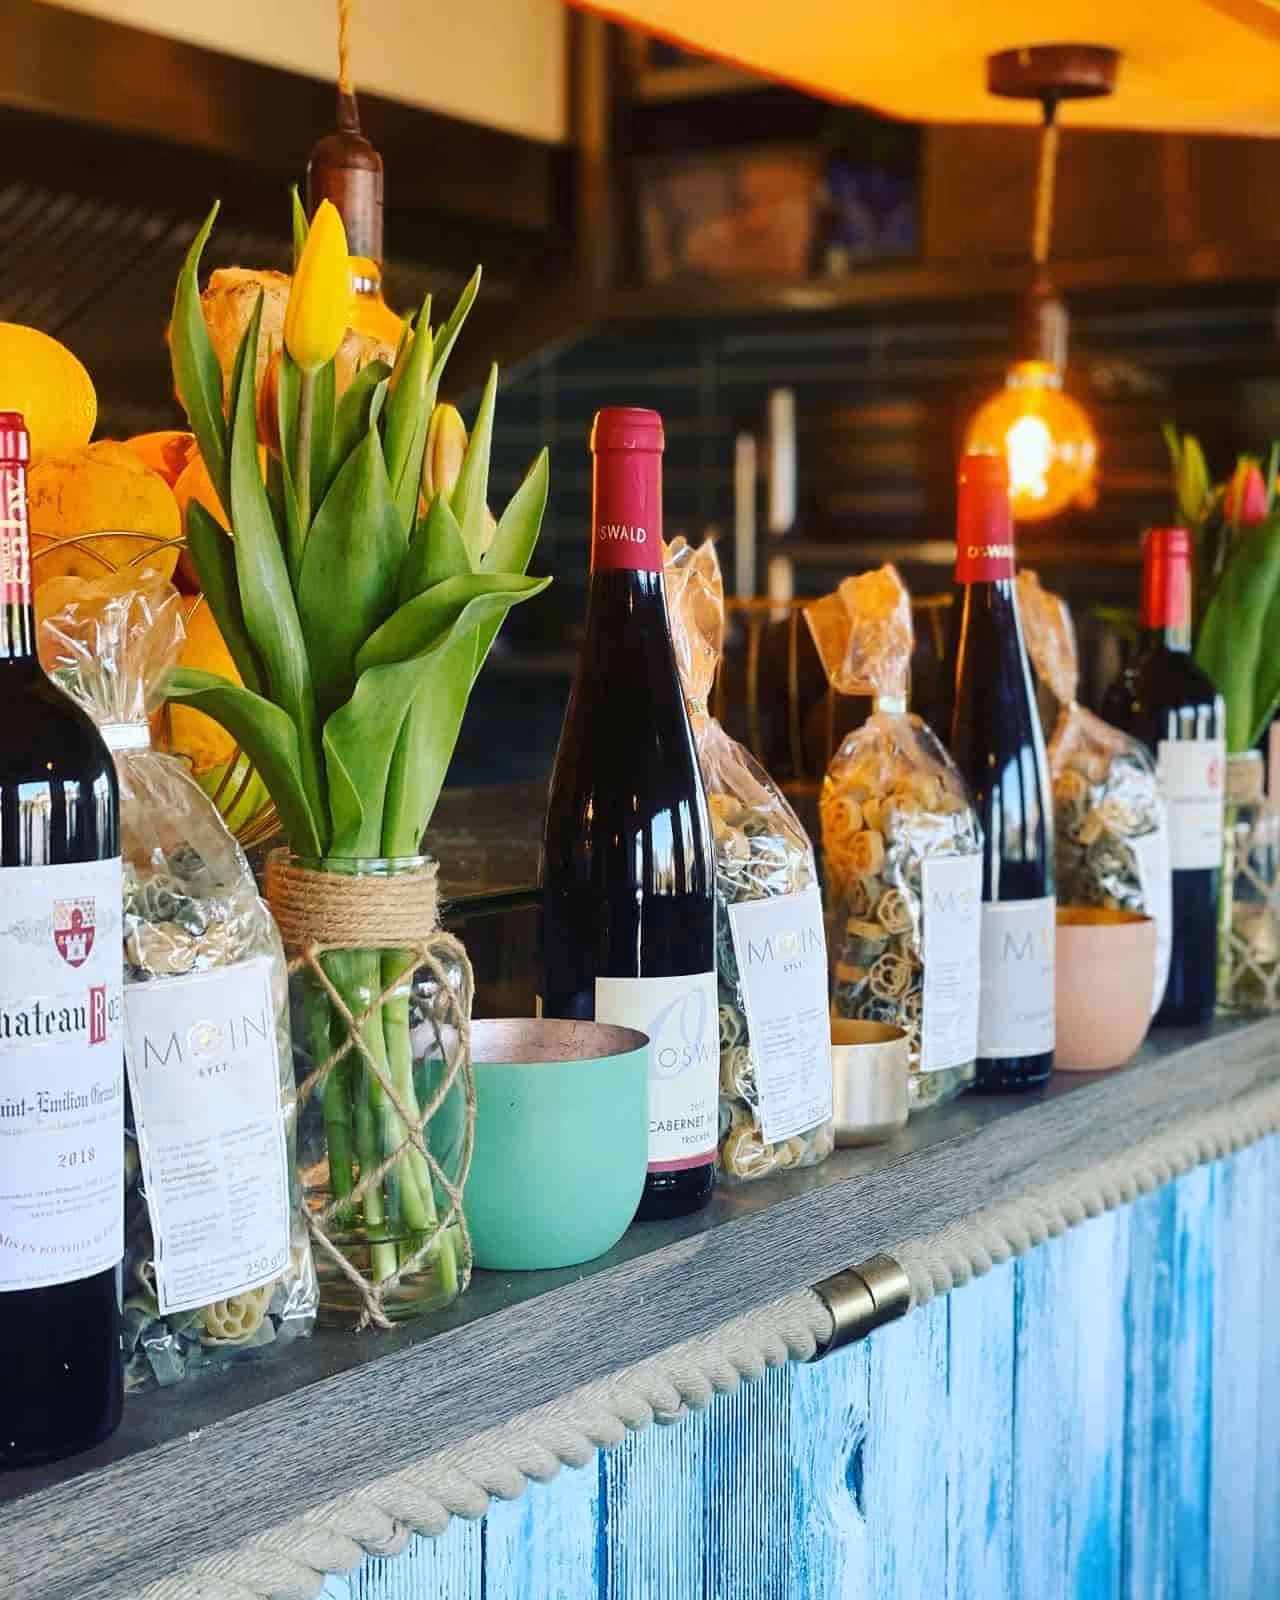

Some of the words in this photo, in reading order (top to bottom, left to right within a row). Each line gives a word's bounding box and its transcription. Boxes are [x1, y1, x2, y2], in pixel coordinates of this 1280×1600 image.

[143, 1009, 269, 1070] MOIN
[199, 1062, 228, 1078] SYLT
[649, 1114, 704, 1133] CABERNET
[56, 1146, 96, 1168] 2018
[246, 1256, 269, 1277] 250
